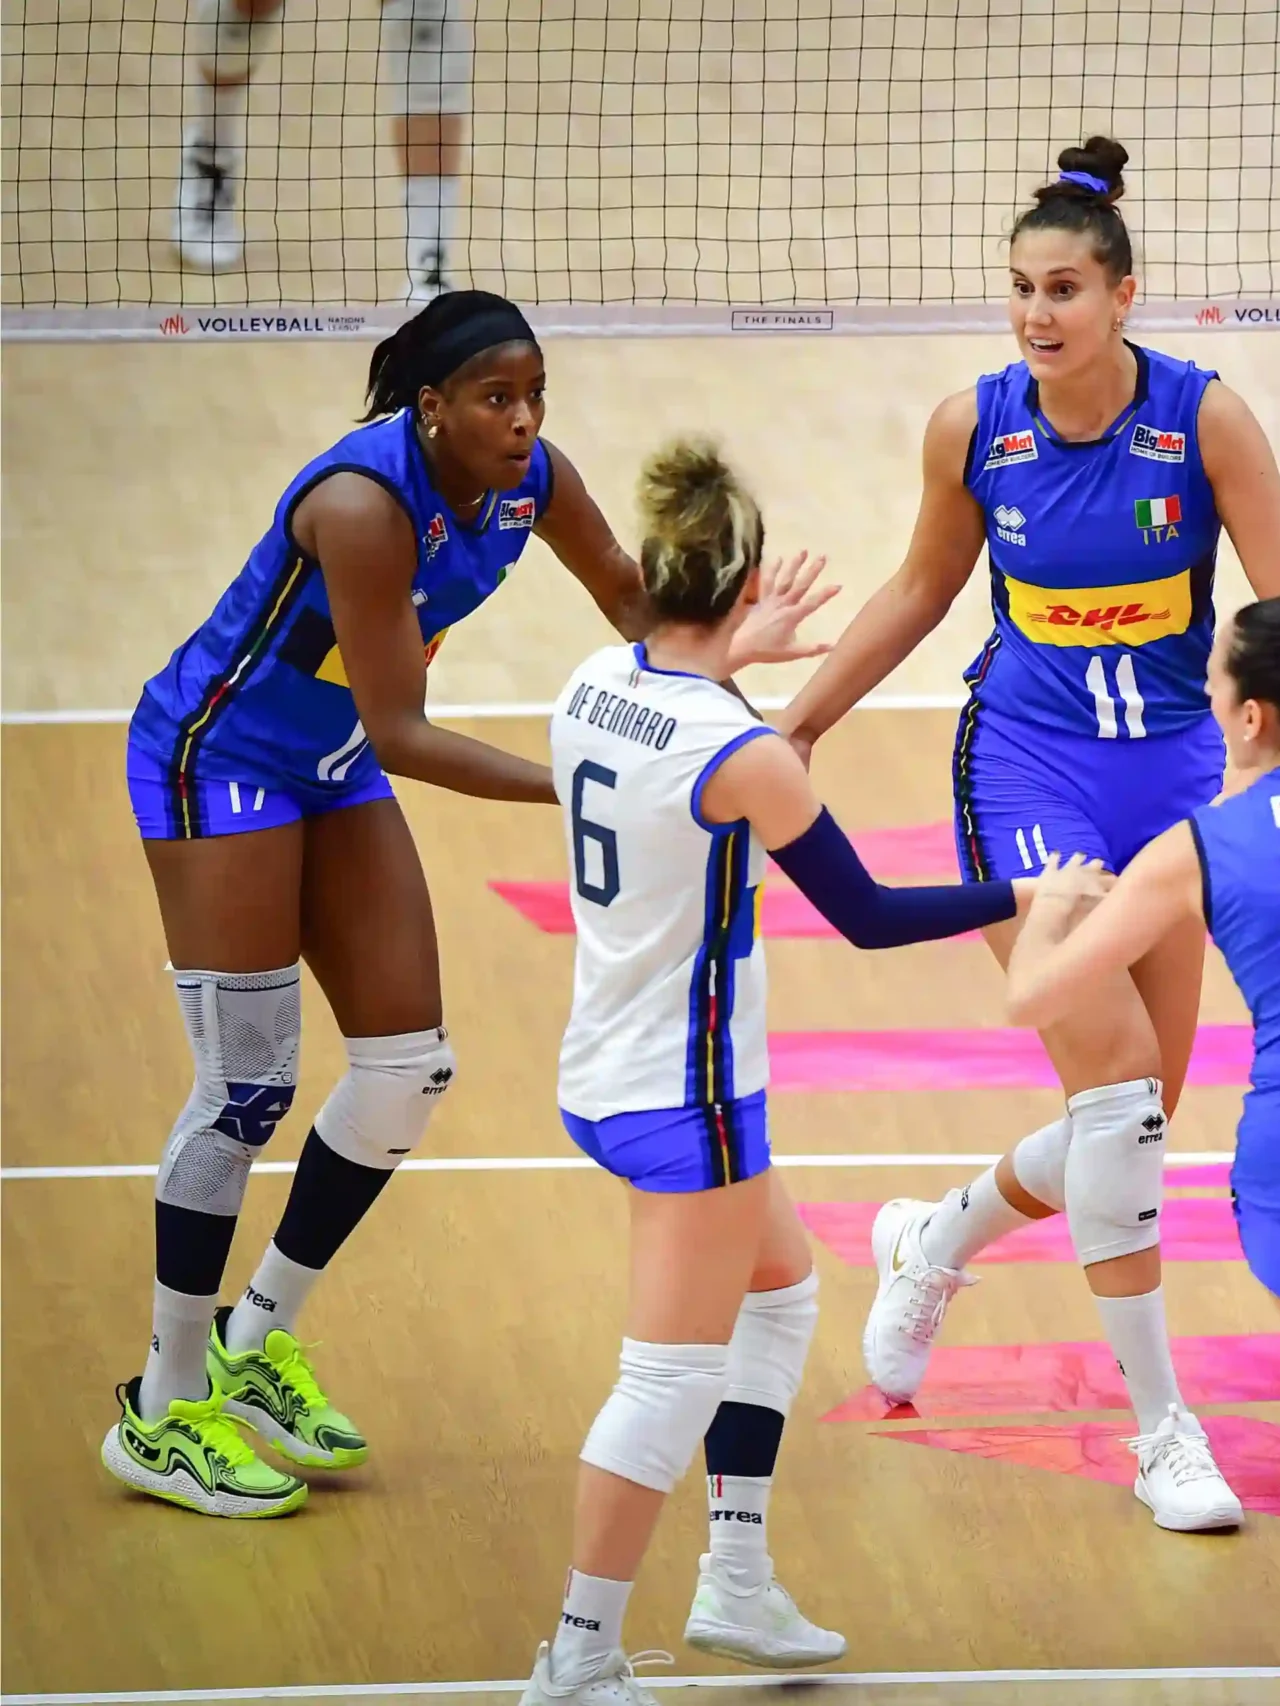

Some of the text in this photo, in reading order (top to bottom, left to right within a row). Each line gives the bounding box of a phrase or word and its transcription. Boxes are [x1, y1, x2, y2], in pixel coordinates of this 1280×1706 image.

[198, 317, 324, 332] VOLLEYBALL
[744, 315, 822, 324] THE FINALS
[989, 434, 1034, 458] igMat
[997, 527, 1026, 546] errea
[1143, 525, 1179, 545] ITA
[1045, 603, 1152, 631] DHL
[1085, 654, 1147, 739] 11
[567, 683, 677, 751] DE GENNARO
[571, 758, 621, 908] 6
[1015, 823, 1049, 870] 11
